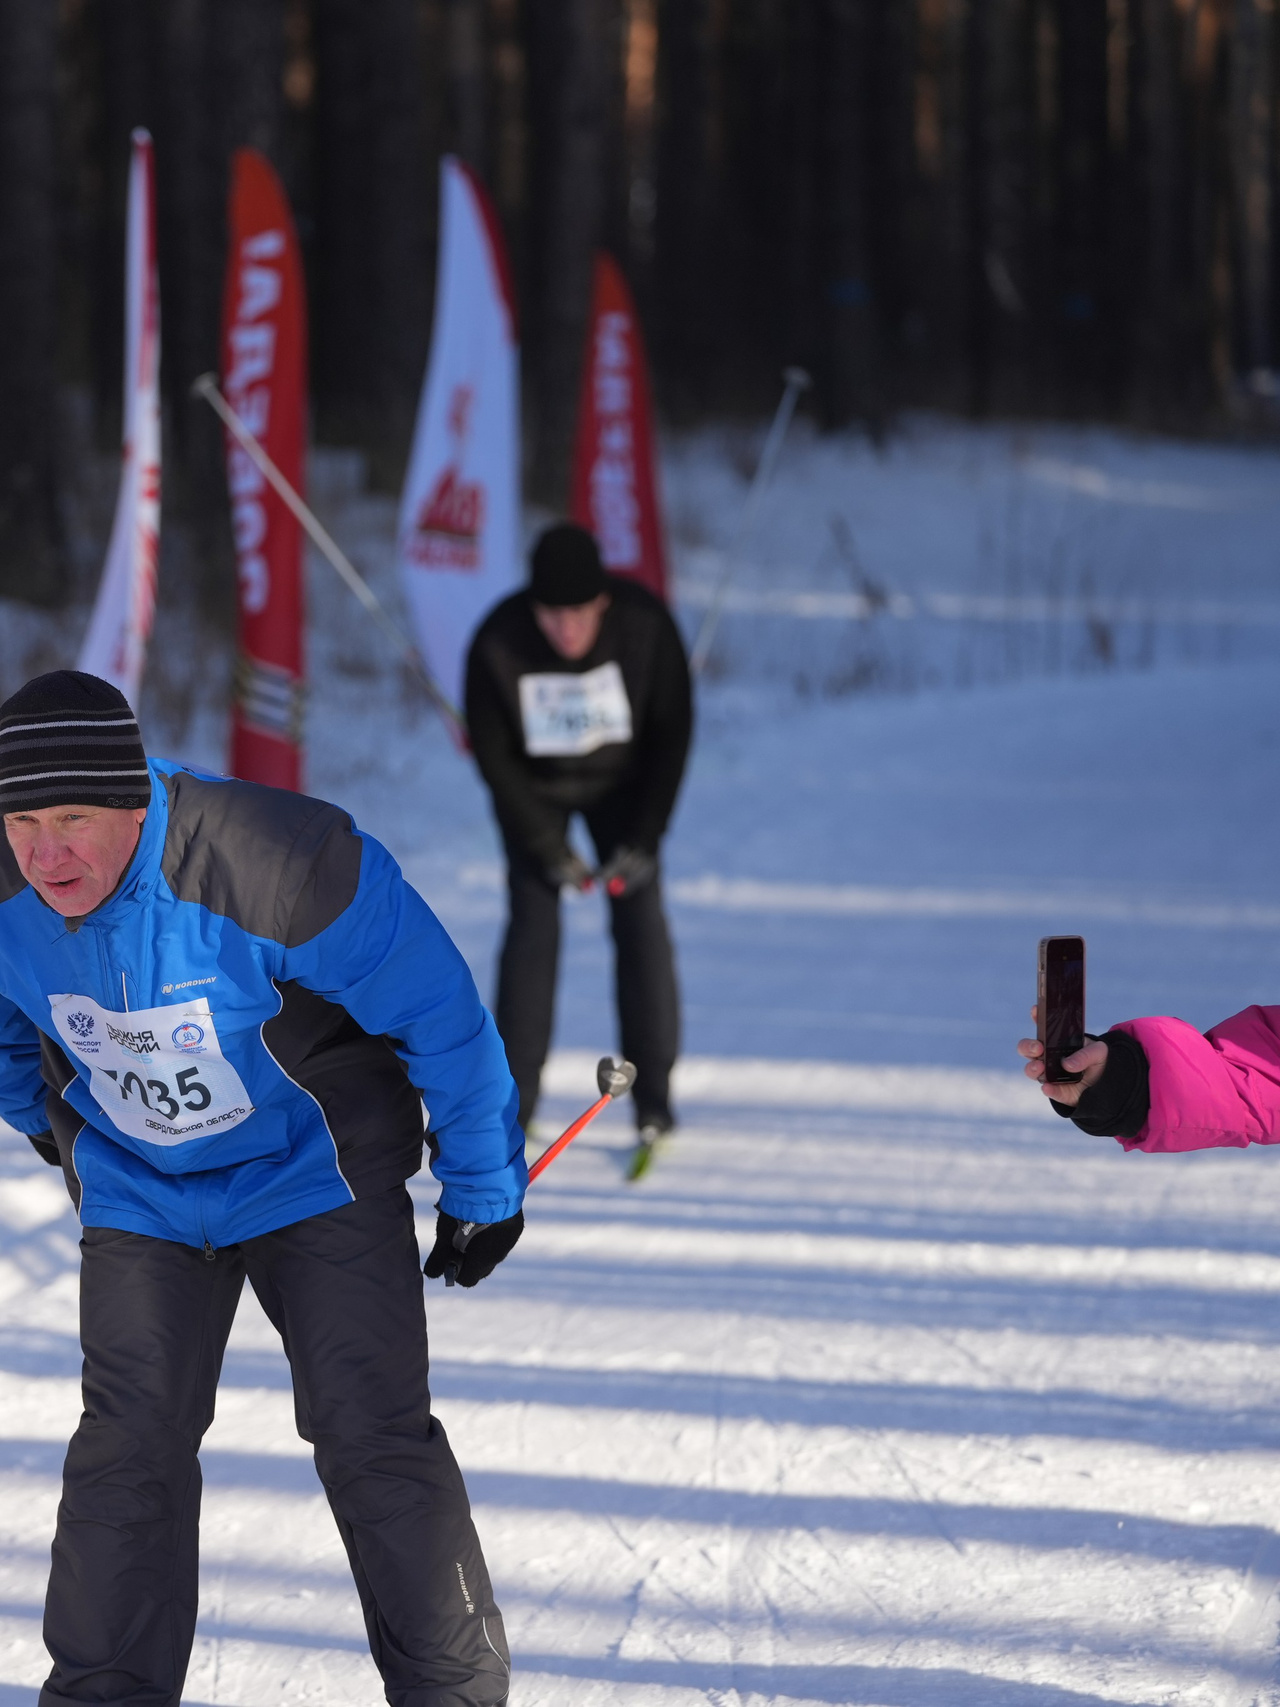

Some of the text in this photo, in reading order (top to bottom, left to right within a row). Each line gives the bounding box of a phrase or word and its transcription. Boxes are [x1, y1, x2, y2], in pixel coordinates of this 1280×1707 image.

[175, 976, 217, 991] NORDWAY
[145, 1107, 246, 1135] СВЕРДЛОВСКАЯ ОБЛАСТЬ
[456, 1563, 471, 1601] NORDWAY
